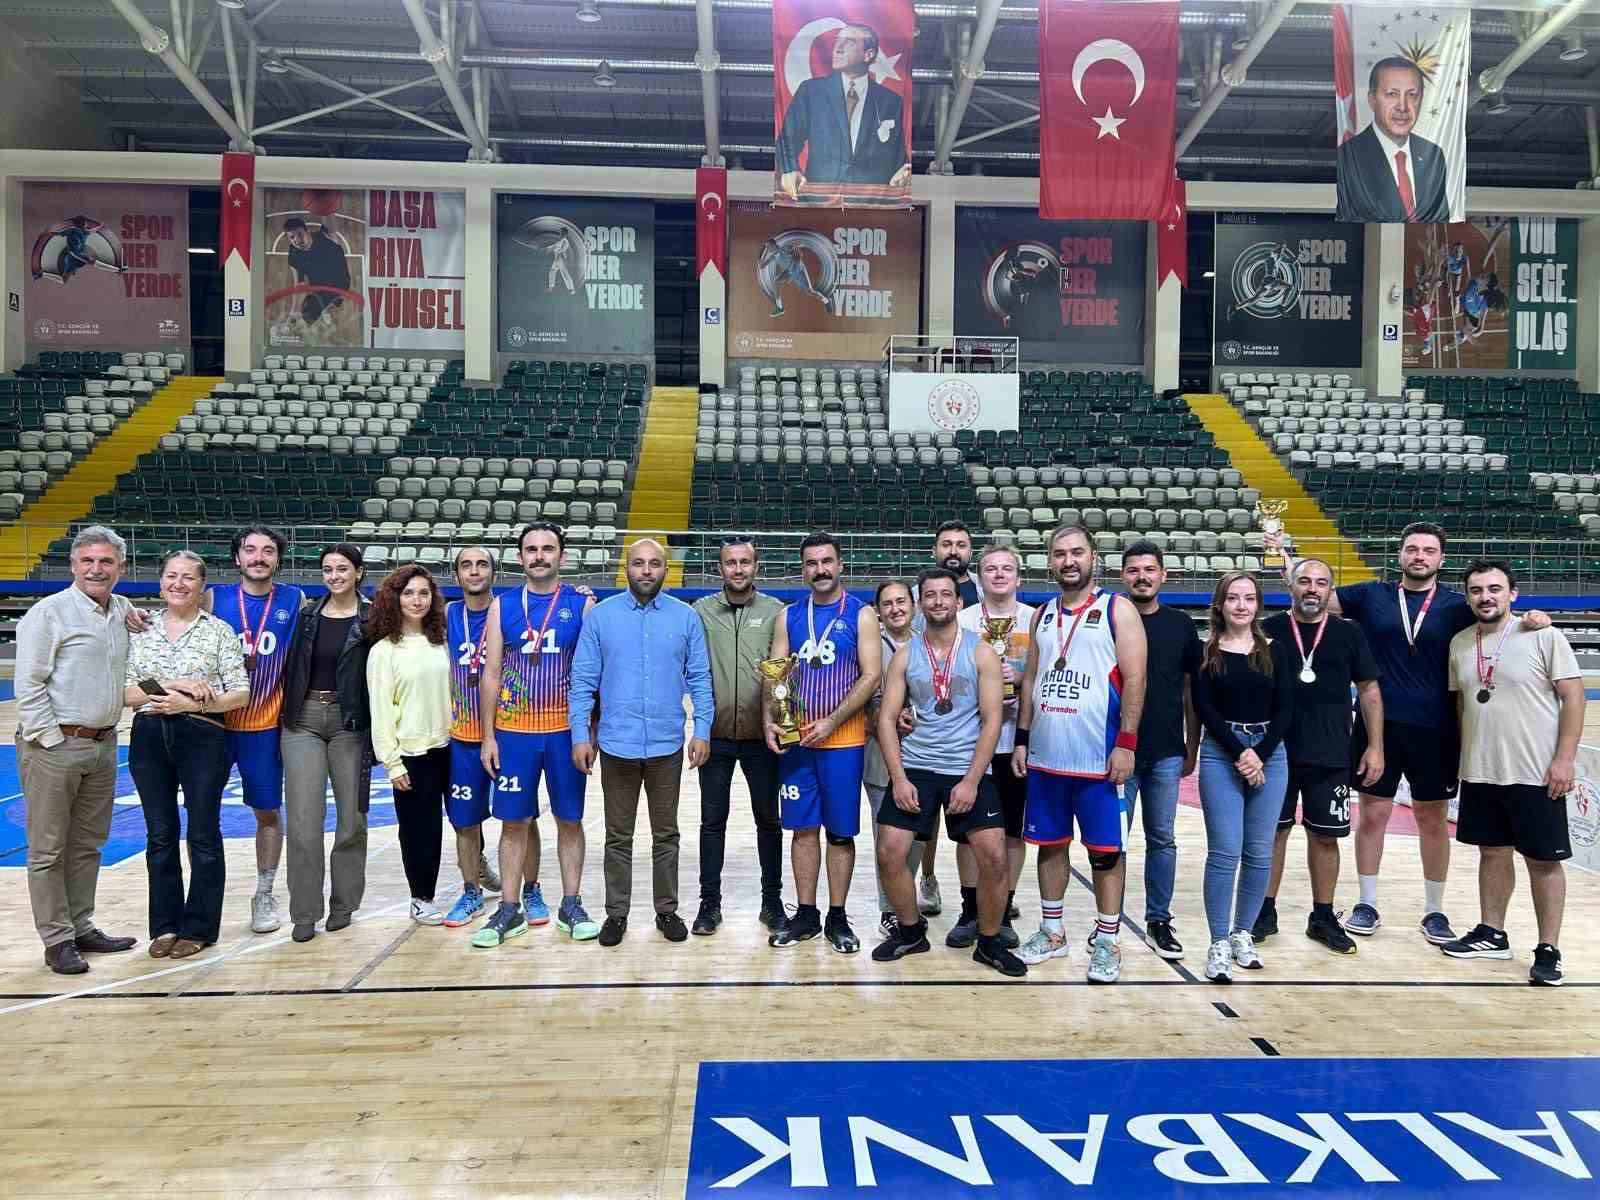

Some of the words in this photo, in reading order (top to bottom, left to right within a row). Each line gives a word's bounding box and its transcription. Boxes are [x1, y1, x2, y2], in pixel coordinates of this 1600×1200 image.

[369, 190, 436, 232] BAŞA
[121, 214, 174, 240] SPOR
[584, 226, 636, 252] SPOR
[833, 227, 887, 256] SPOR
[1060, 237, 1112, 264] SPOR
[1299, 240, 1347, 263] SPOR
[122, 242, 158, 268] HER
[584, 255, 620, 280] HER
[122, 272, 183, 298] YERDE
[835, 258, 870, 286] HER
[1298, 267, 1331, 291] HER
[231, 300, 241, 311] B
[368, 283, 465, 330] YÜKSEL
[585, 283, 643, 310] YERDE
[833, 290, 893, 317] YERDE
[1298, 295, 1351, 320] YERDE
[707, 308, 717, 320] C
[1060, 298, 1120, 325] YERDE
[1385, 325, 1396, 336] D
[1516, 311, 1568, 355] ULAŞ
[520, 629, 560, 653] 21
[799, 640, 836, 665] 48
[1042, 684, 1079, 699] EFES
[451, 784, 472, 800] 23
[498, 776, 522, 791] 21
[781, 784, 800, 800] 48
[707, 1110, 1600, 1189] ALKBANK
